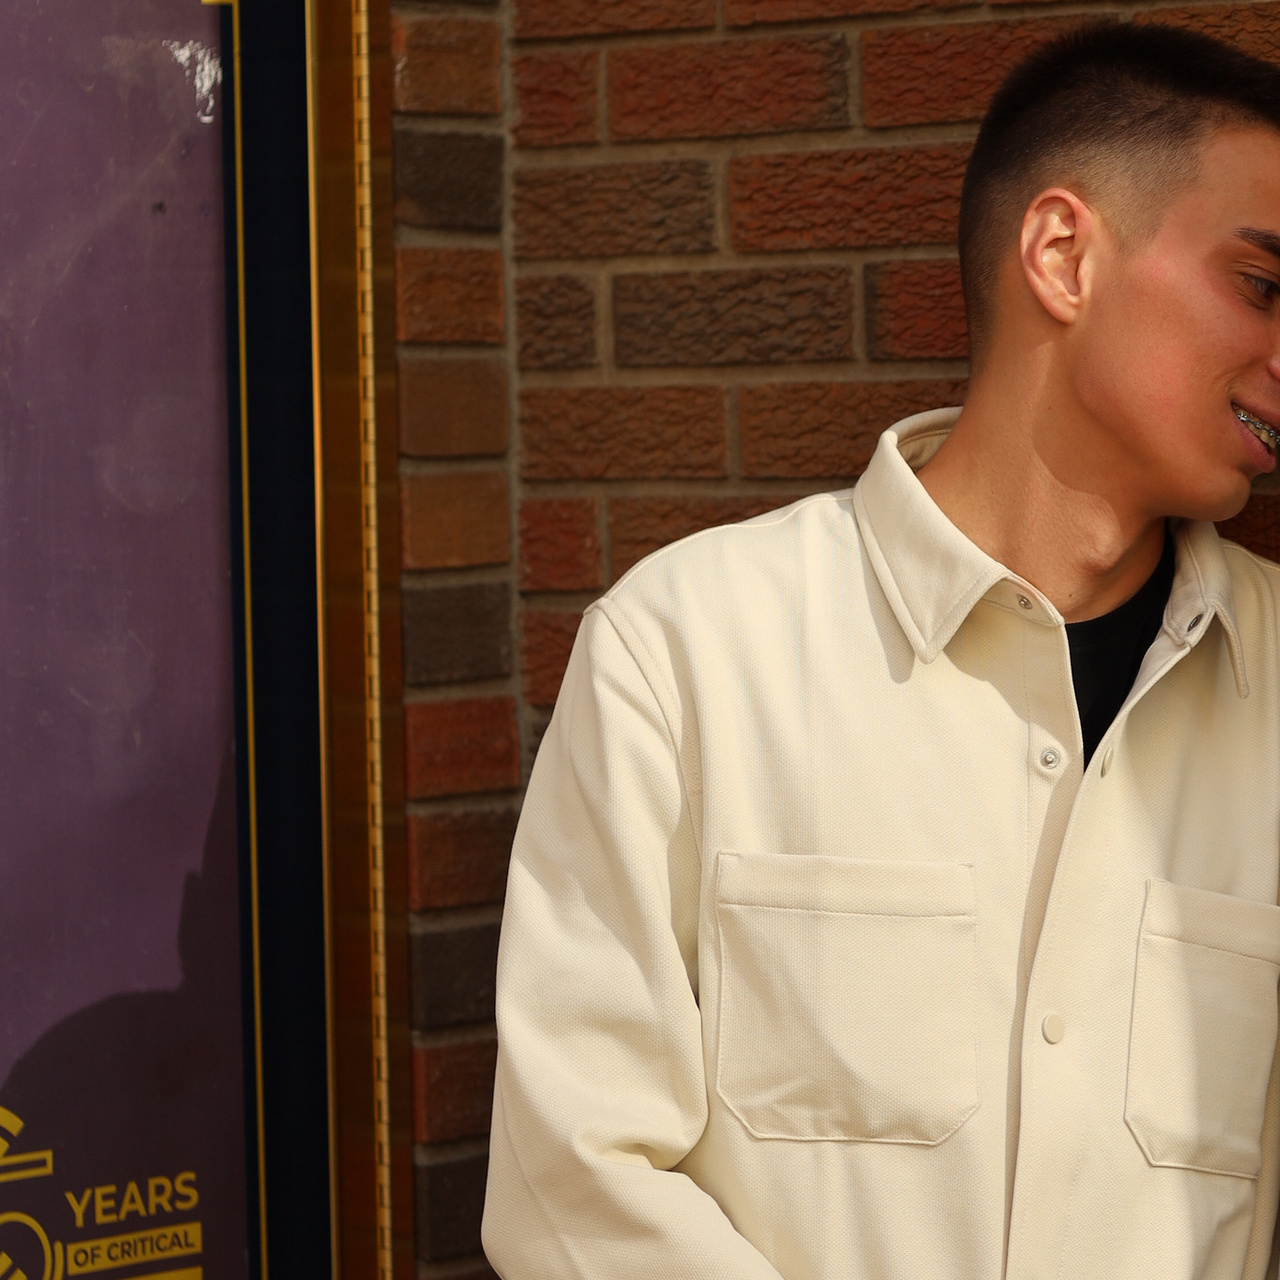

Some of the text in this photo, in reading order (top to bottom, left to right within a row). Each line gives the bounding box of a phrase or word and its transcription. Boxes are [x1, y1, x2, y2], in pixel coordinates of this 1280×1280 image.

[64, 1171, 200, 1228] YEARS
[73, 1231, 195, 1268] OF CRITICAL
